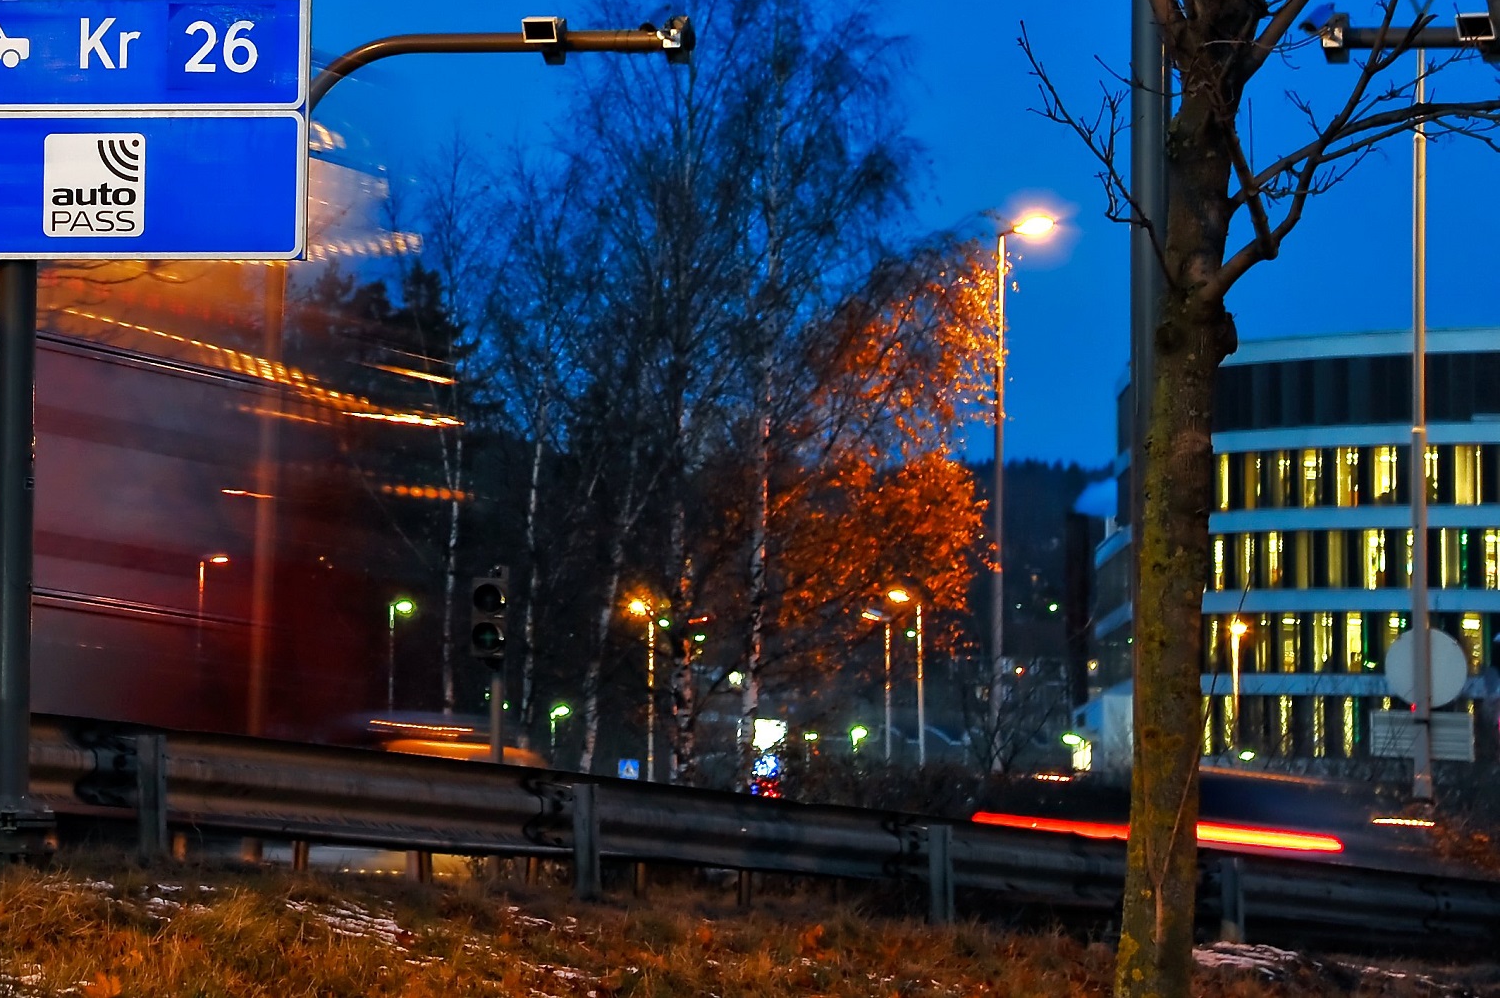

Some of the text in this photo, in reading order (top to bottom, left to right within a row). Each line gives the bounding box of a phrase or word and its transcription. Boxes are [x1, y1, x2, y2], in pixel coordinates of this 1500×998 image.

[79, 18, 259, 74] Kr 26
[51, 183, 137, 207] auto
[51, 210, 136, 232] PASS
